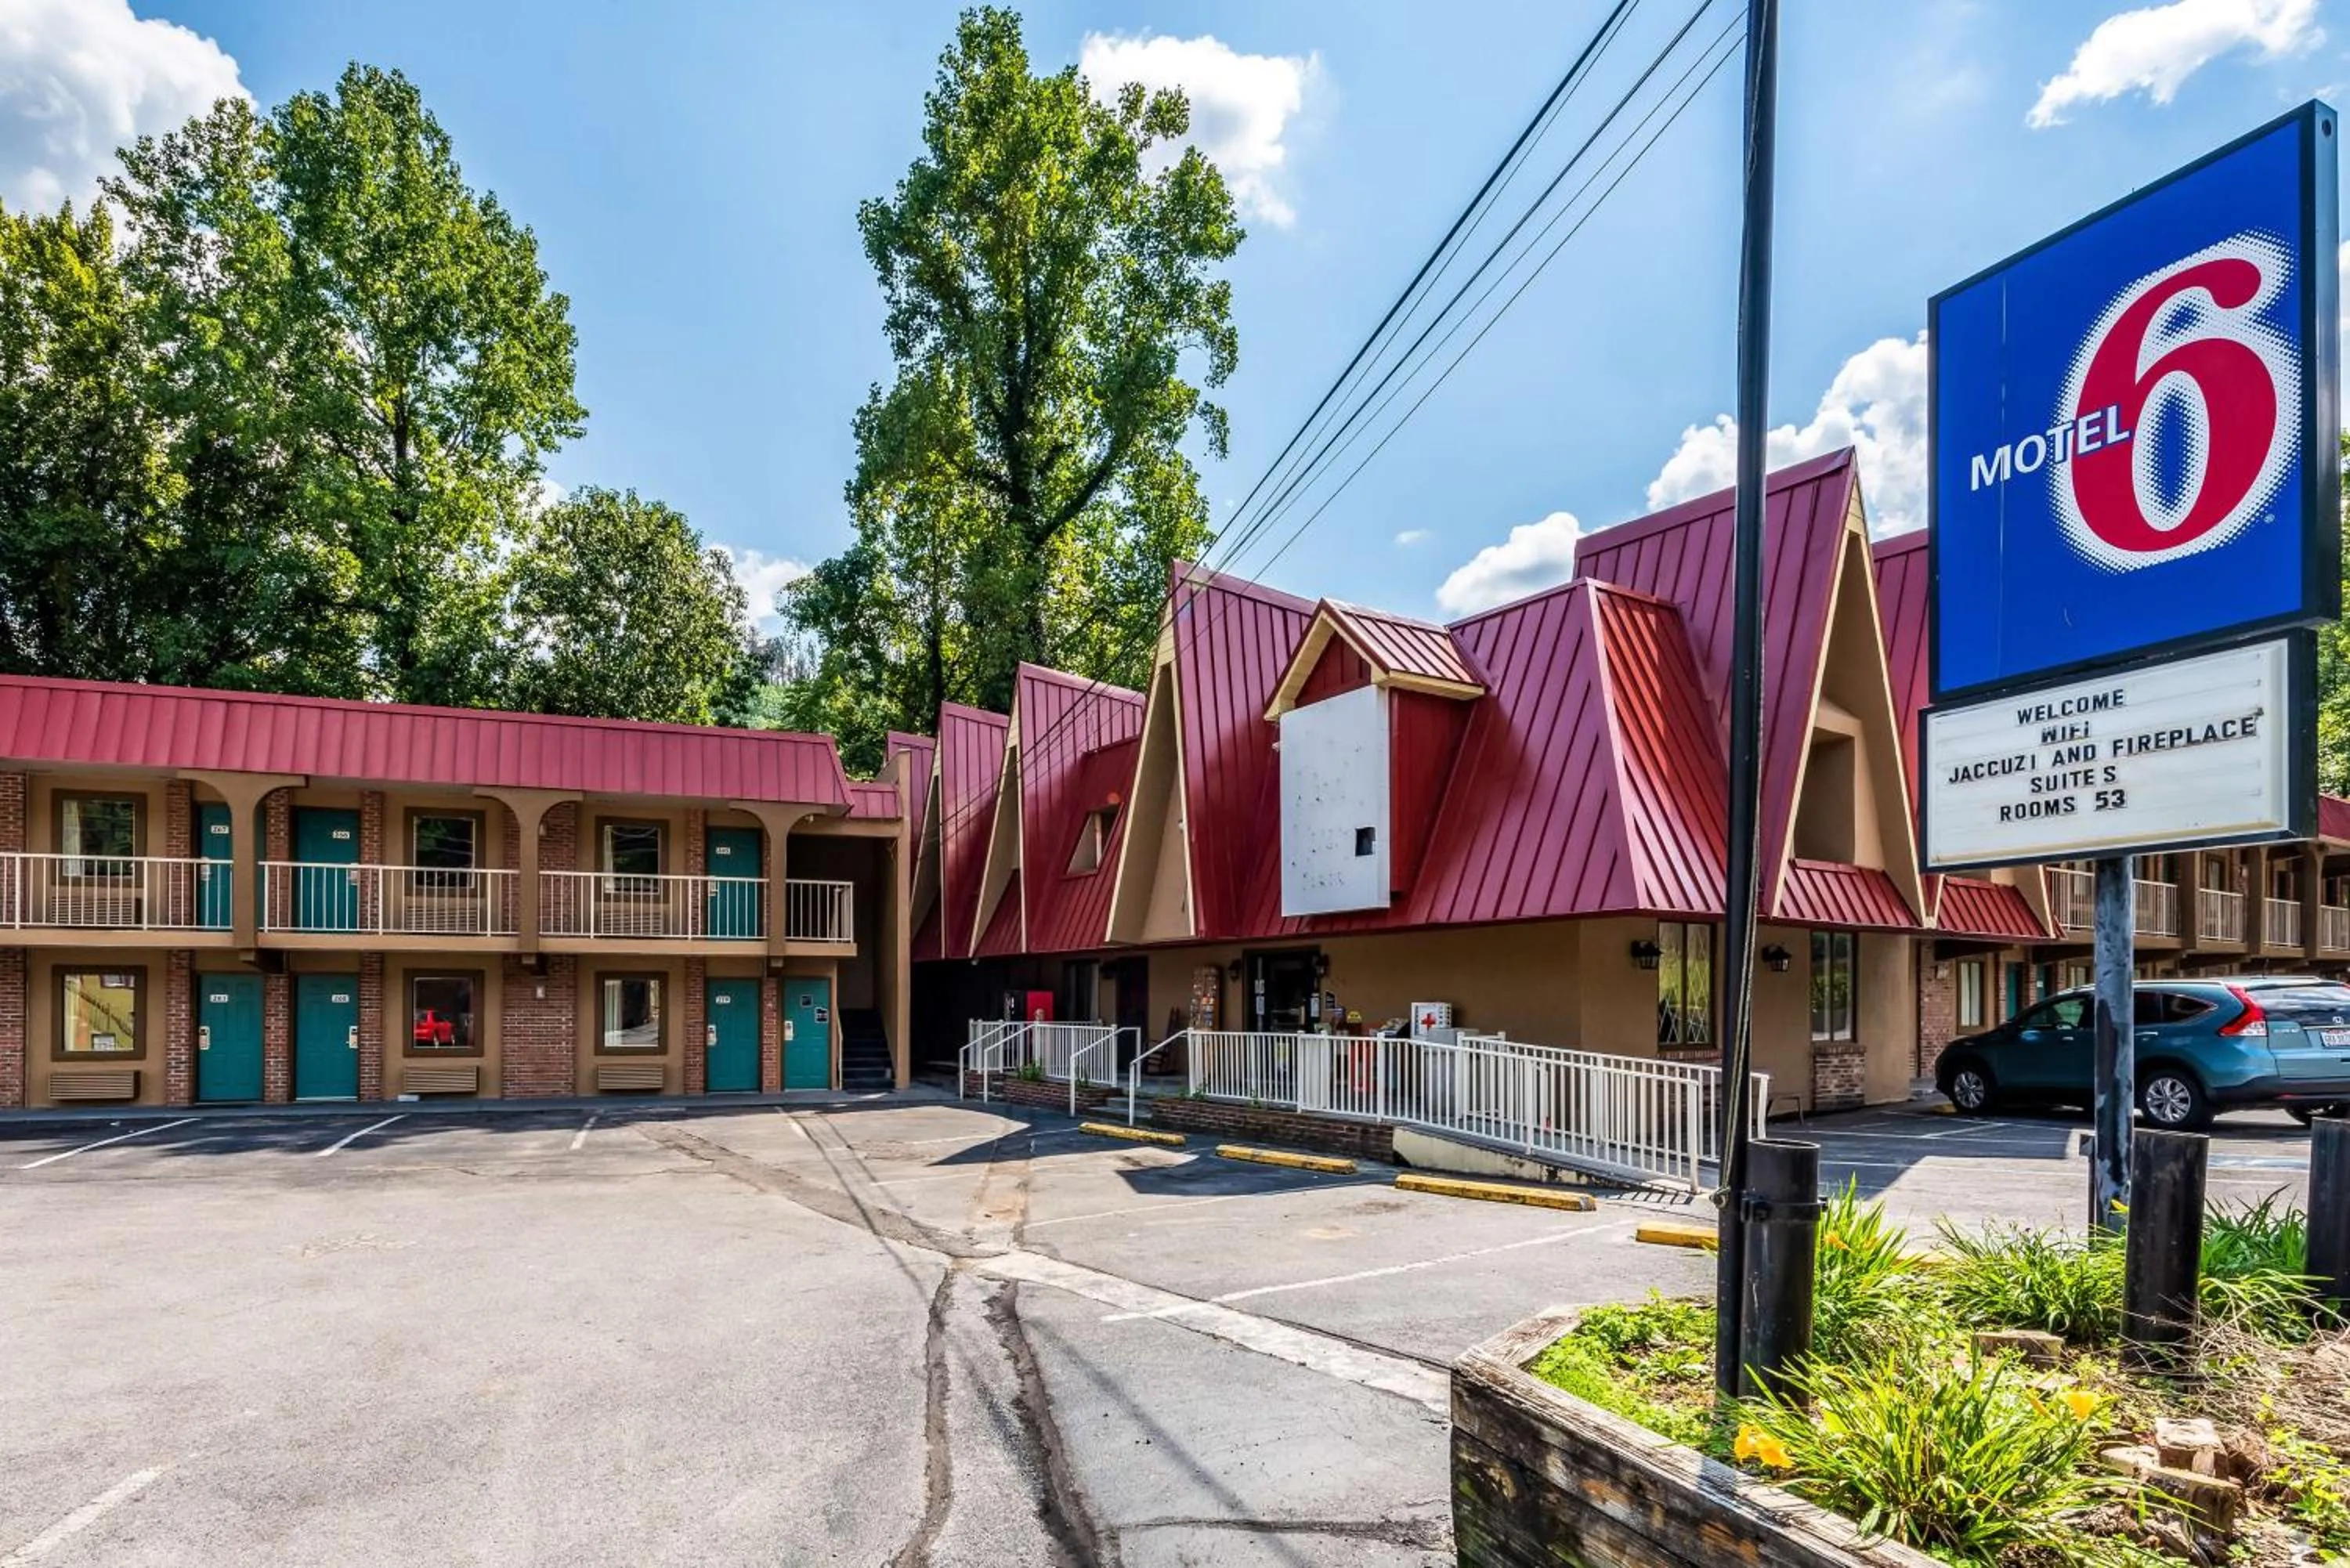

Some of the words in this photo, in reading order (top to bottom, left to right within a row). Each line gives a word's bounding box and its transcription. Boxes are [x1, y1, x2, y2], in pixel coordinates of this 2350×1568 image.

[1970, 404, 2130, 492] MOTEL
[2070, 258, 2277, 553] 6
[2017, 688, 2124, 725] WELCOME
[1948, 754, 2036, 784] JACCUZI
[2052, 744, 2097, 768] AND
[2113, 717, 2255, 758] FIREPLACE
[1999, 796, 2076, 822] ROOMS
[2095, 789, 2126, 811] 53
